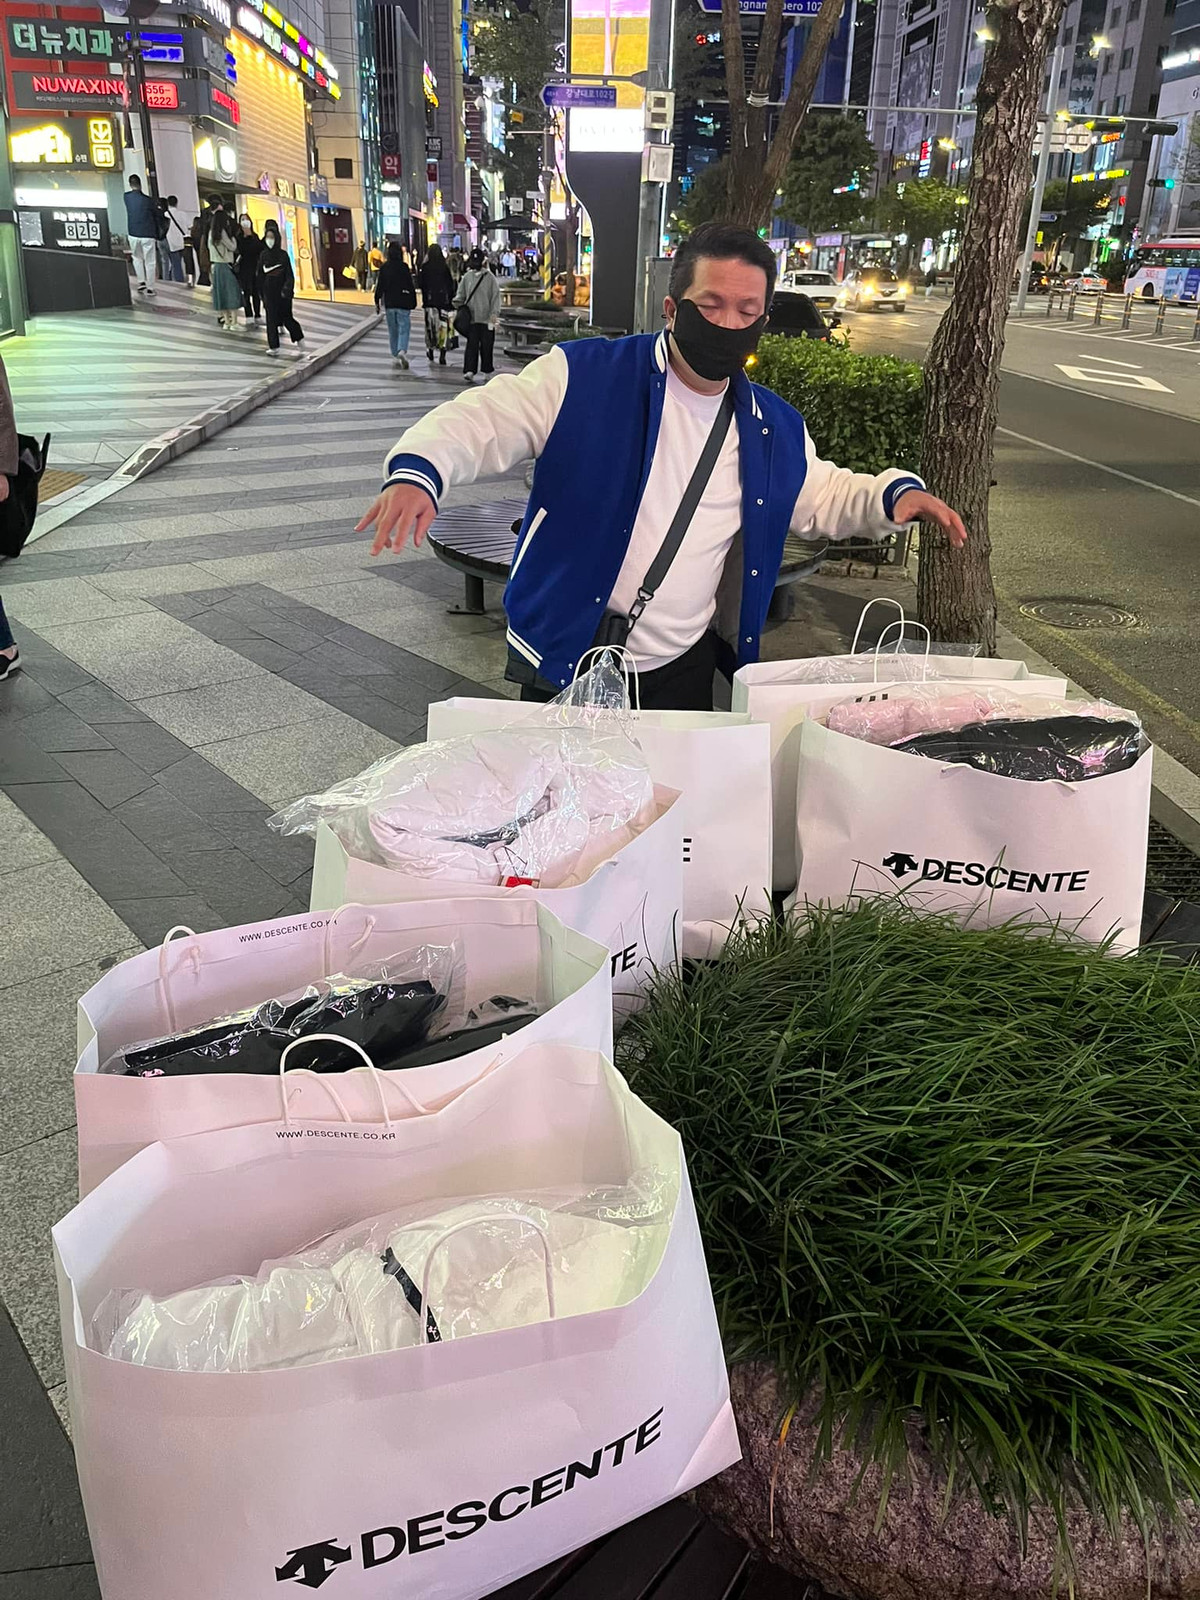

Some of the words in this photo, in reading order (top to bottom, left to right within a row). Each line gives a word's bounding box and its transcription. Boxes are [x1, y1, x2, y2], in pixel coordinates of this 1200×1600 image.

[13, 23, 114, 57] 더뉴치과
[921, 858, 1090, 893] DESCENTE
[239, 919, 338, 943] WWW.DESCENTE.CO.K
[276, 1130, 396, 1140] WWW.DESCENTE.CO.KR
[360, 1405, 664, 1570] DESCENTE
